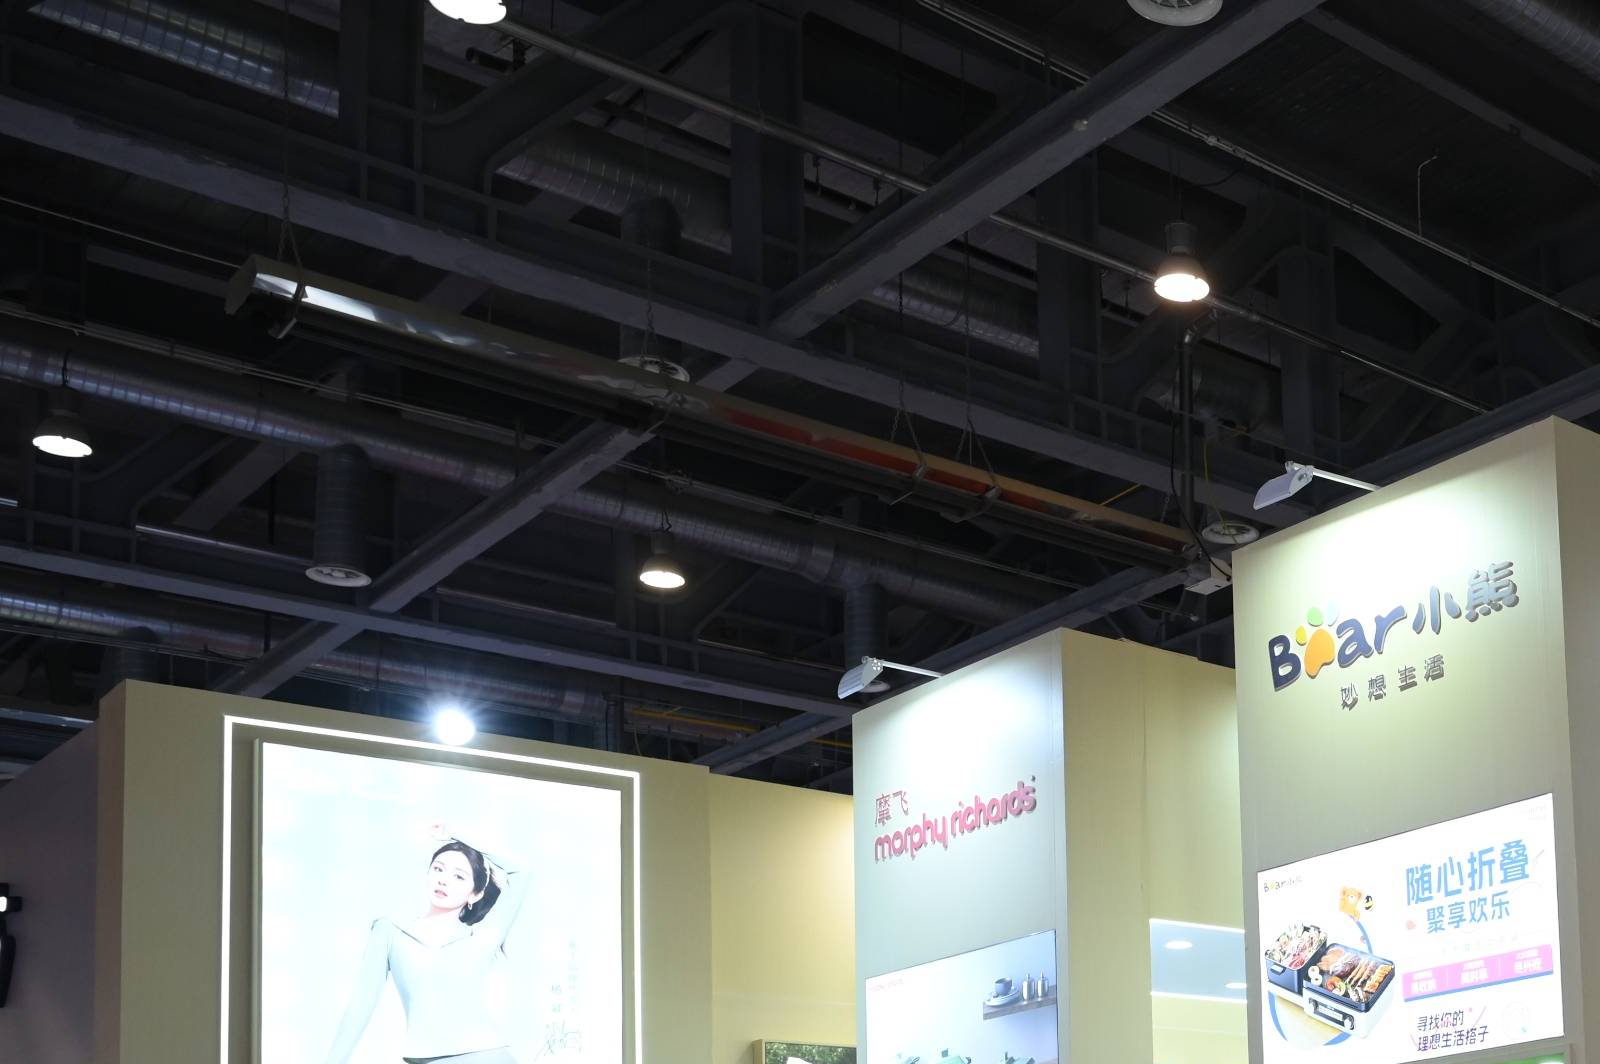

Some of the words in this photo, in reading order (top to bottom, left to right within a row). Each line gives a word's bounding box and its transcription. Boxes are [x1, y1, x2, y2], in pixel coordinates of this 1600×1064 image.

[1411, 560, 1521, 634] 小熊
[1339, 653, 1446, 711] 妙想生活
[874, 790, 910, 826] 摩飞
[874, 812, 949, 862] morphy
[950, 783, 1037, 838] richards
[1405, 839, 1530, 906] 随心折叠
[1426, 890, 1511, 934] 聚享欢乐
[1416, 1024, 1489, 1052] 理想生活搭子
[1417, 1010, 1465, 1031] 寻找你的
